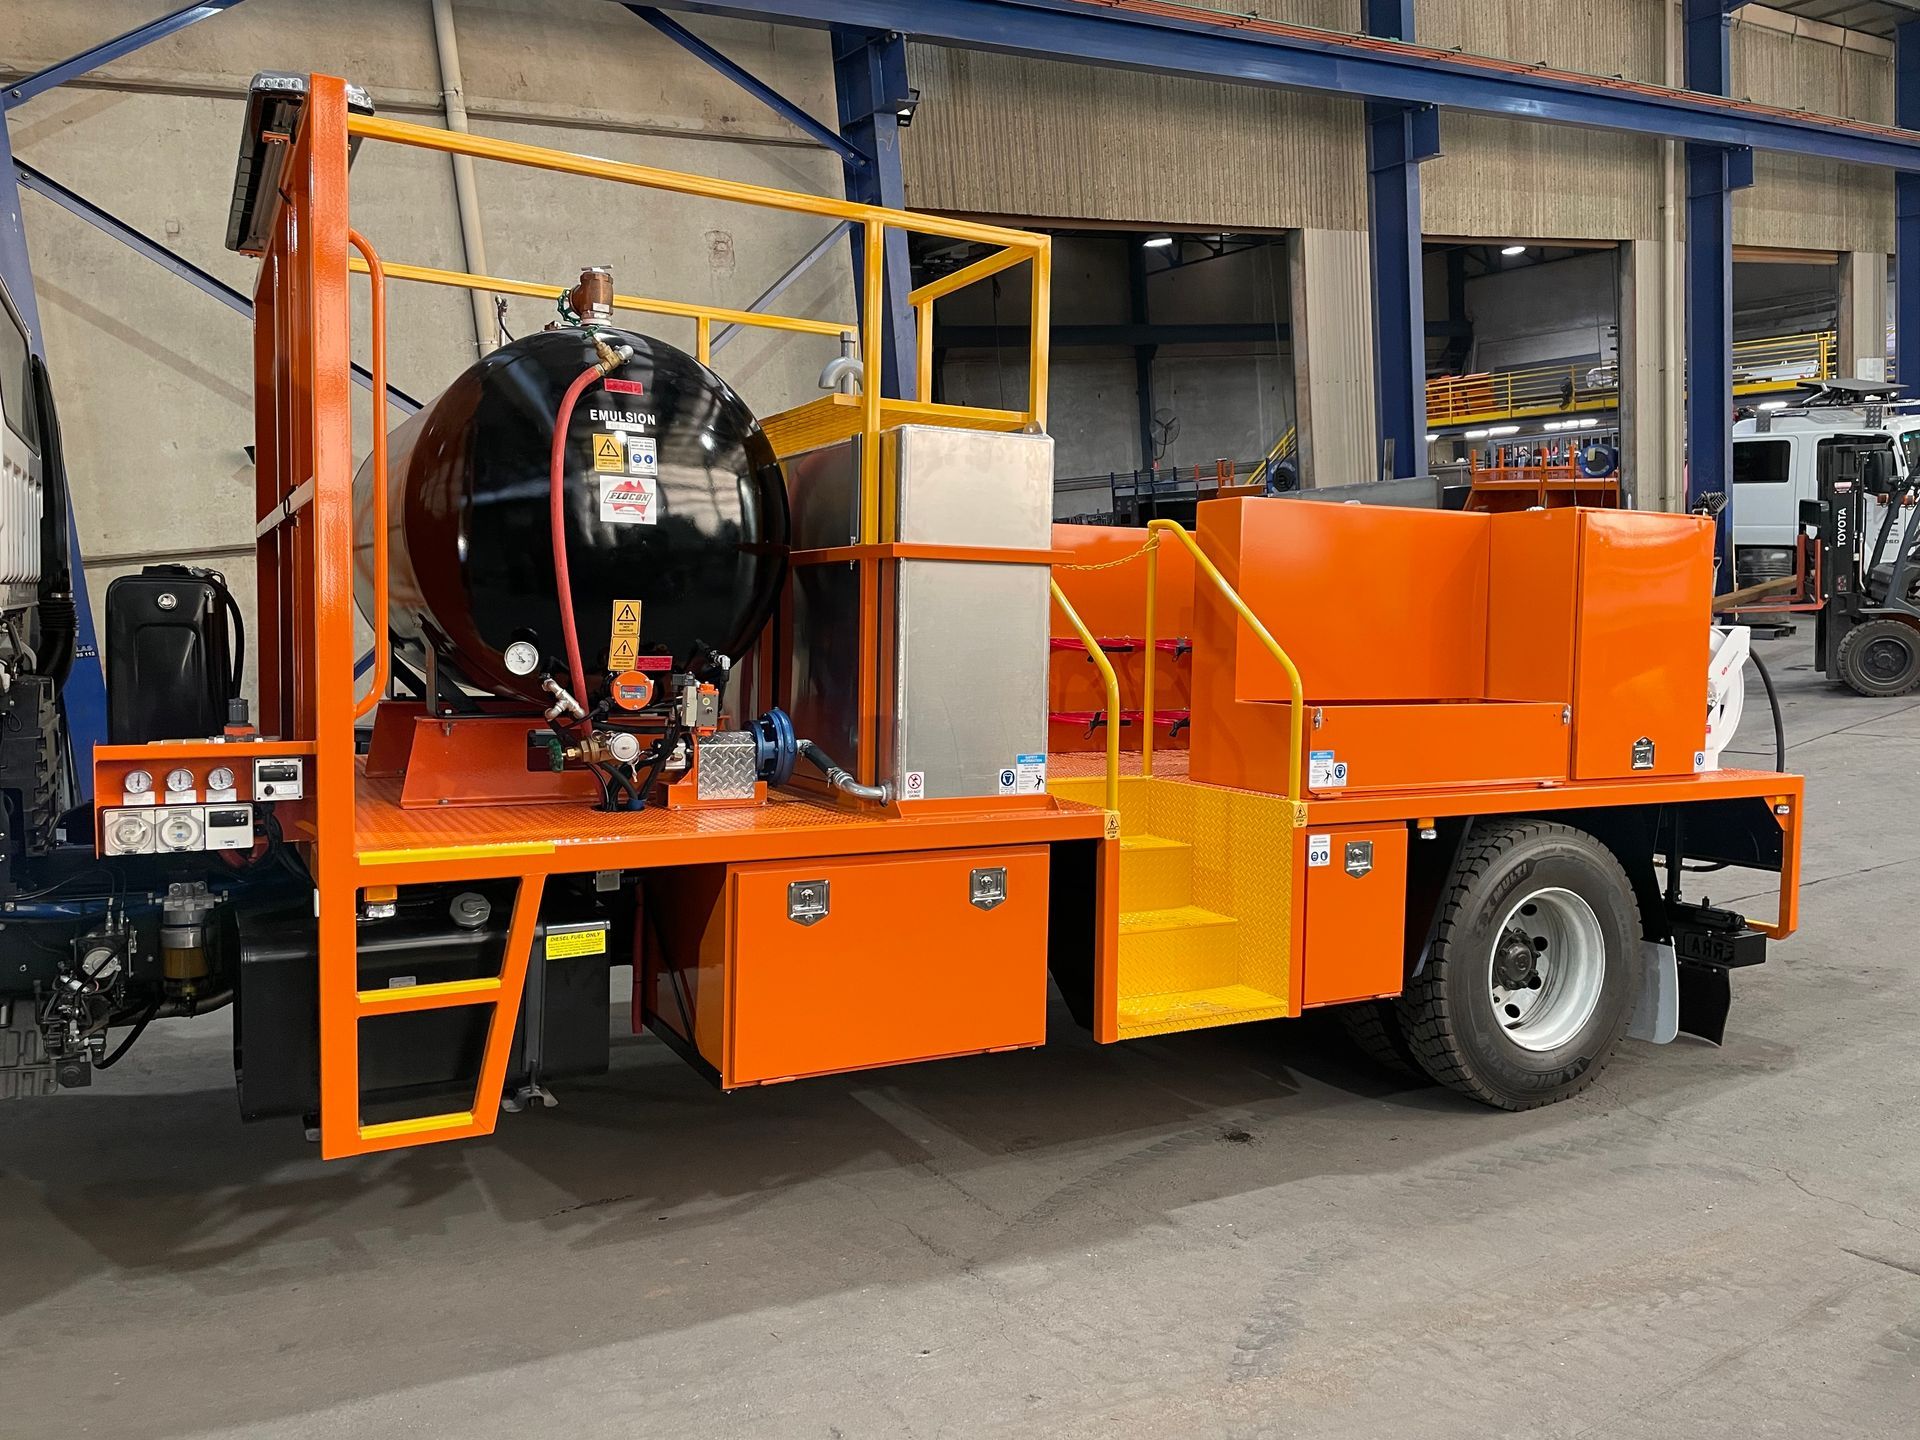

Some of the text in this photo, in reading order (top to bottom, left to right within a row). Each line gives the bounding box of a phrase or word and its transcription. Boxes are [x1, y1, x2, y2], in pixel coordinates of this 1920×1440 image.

[590, 409, 656, 425] EMULSION
[609, 492, 650, 501] FLOCON
[1837, 508, 1847, 547] TOYOTA
